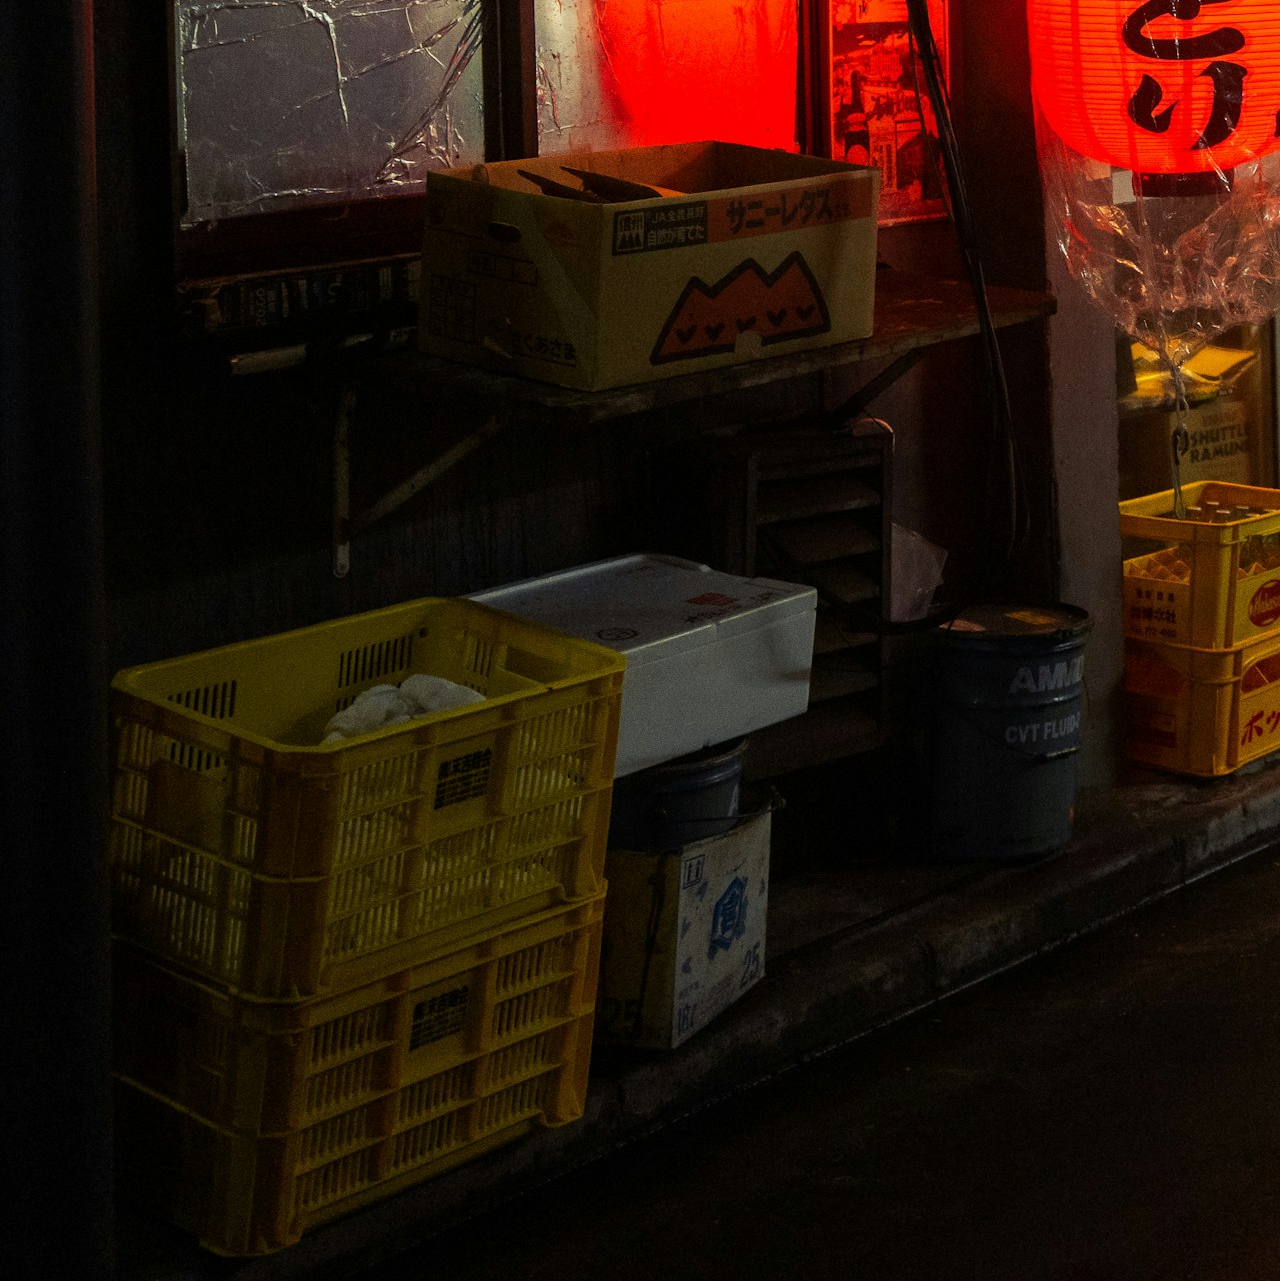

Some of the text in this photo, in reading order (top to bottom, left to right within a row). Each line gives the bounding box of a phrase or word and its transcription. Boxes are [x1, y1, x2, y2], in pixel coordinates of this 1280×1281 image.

[728, 190, 834, 233] サニーレタス
[647, 225, 706, 247] 自然が育てた
[1004, 723, 1041, 745] CVT
